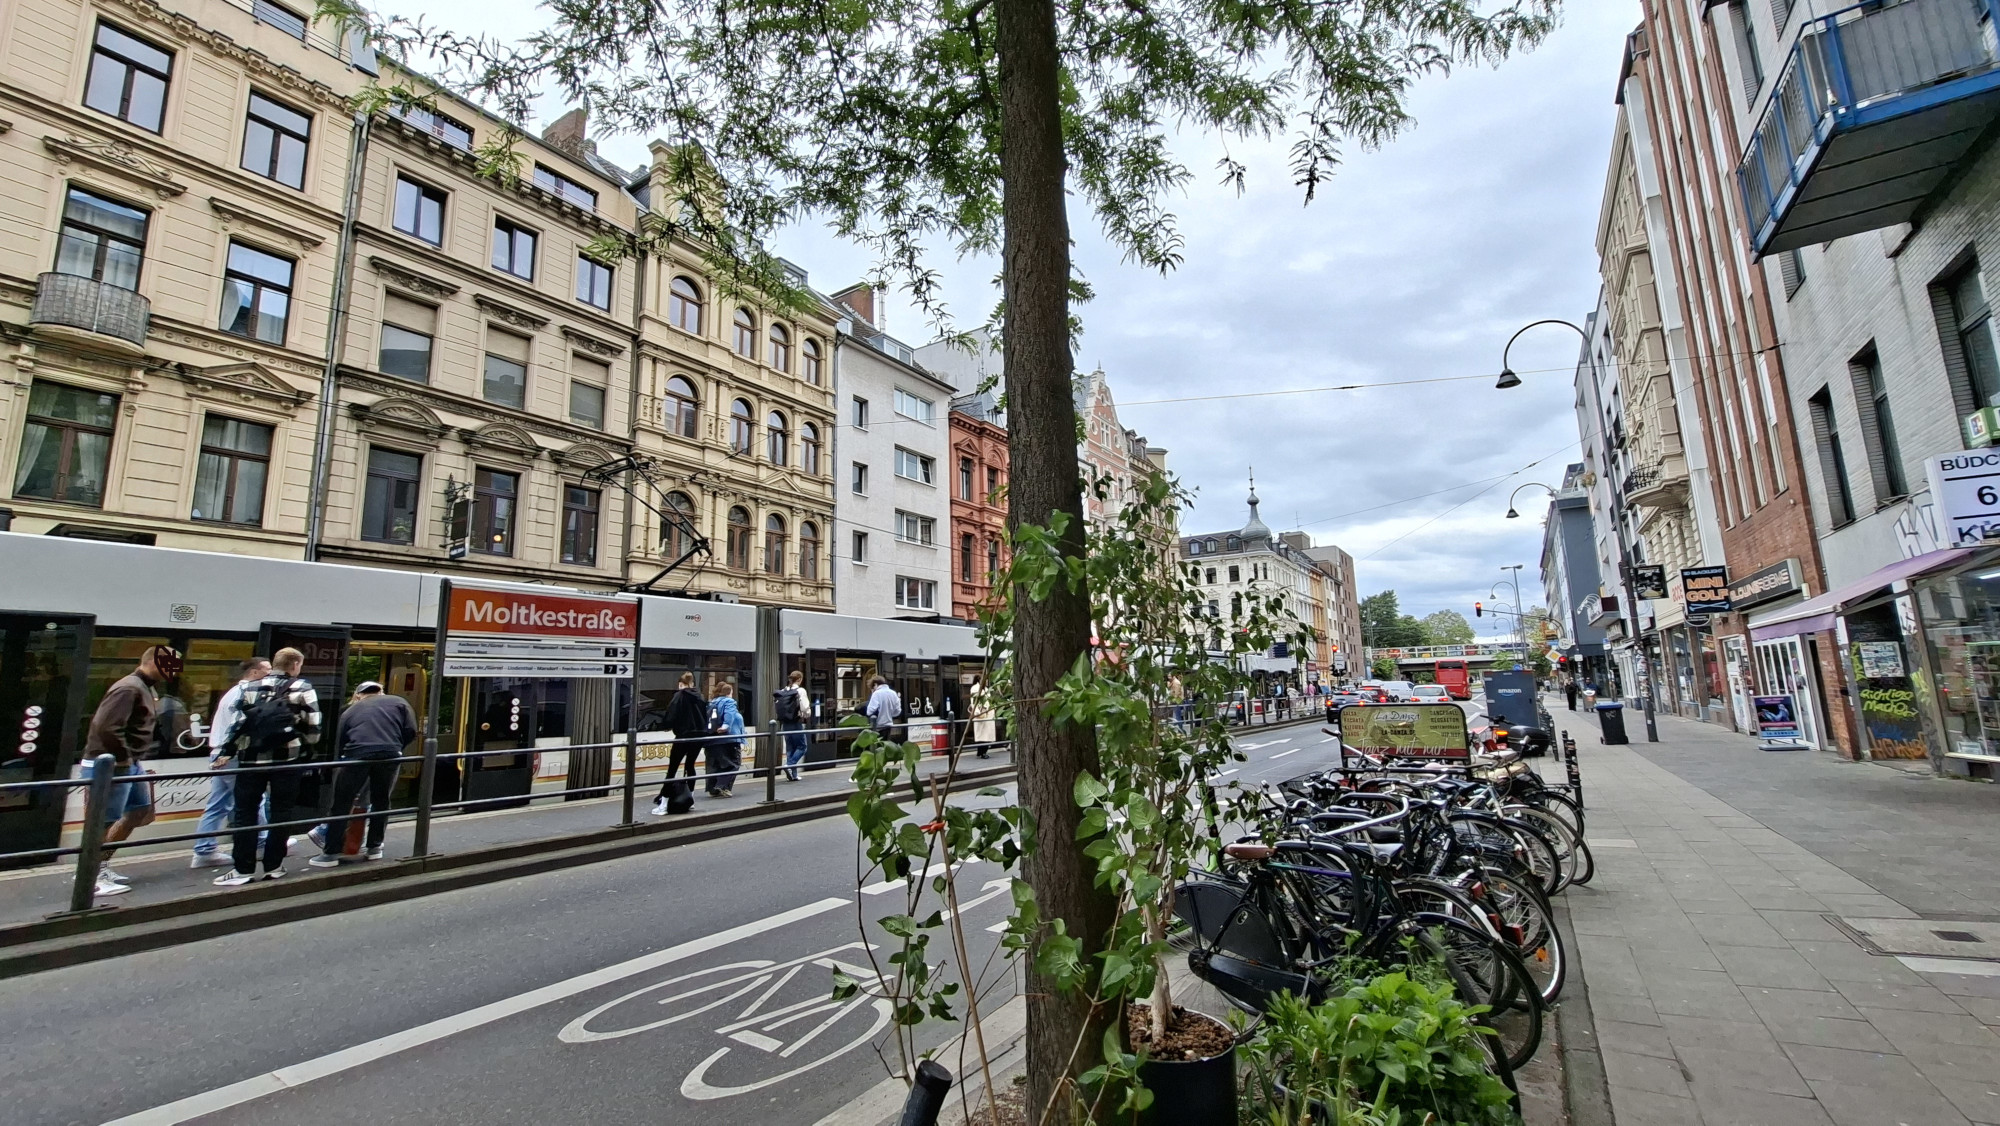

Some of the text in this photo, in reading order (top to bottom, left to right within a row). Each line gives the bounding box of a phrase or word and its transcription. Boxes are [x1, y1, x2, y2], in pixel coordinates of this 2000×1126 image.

[1940, 454, 2000, 471] BÜDC
[1686, 576, 1724, 589] MINI
[1686, 588, 1729, 602] GOLF
[464, 599, 626, 631] Moltkestraße
[1376, 710, 1420, 720] La Danza
[1358, 737, 1390, 756] Tanz
[1396, 736, 1419, 756] mit
